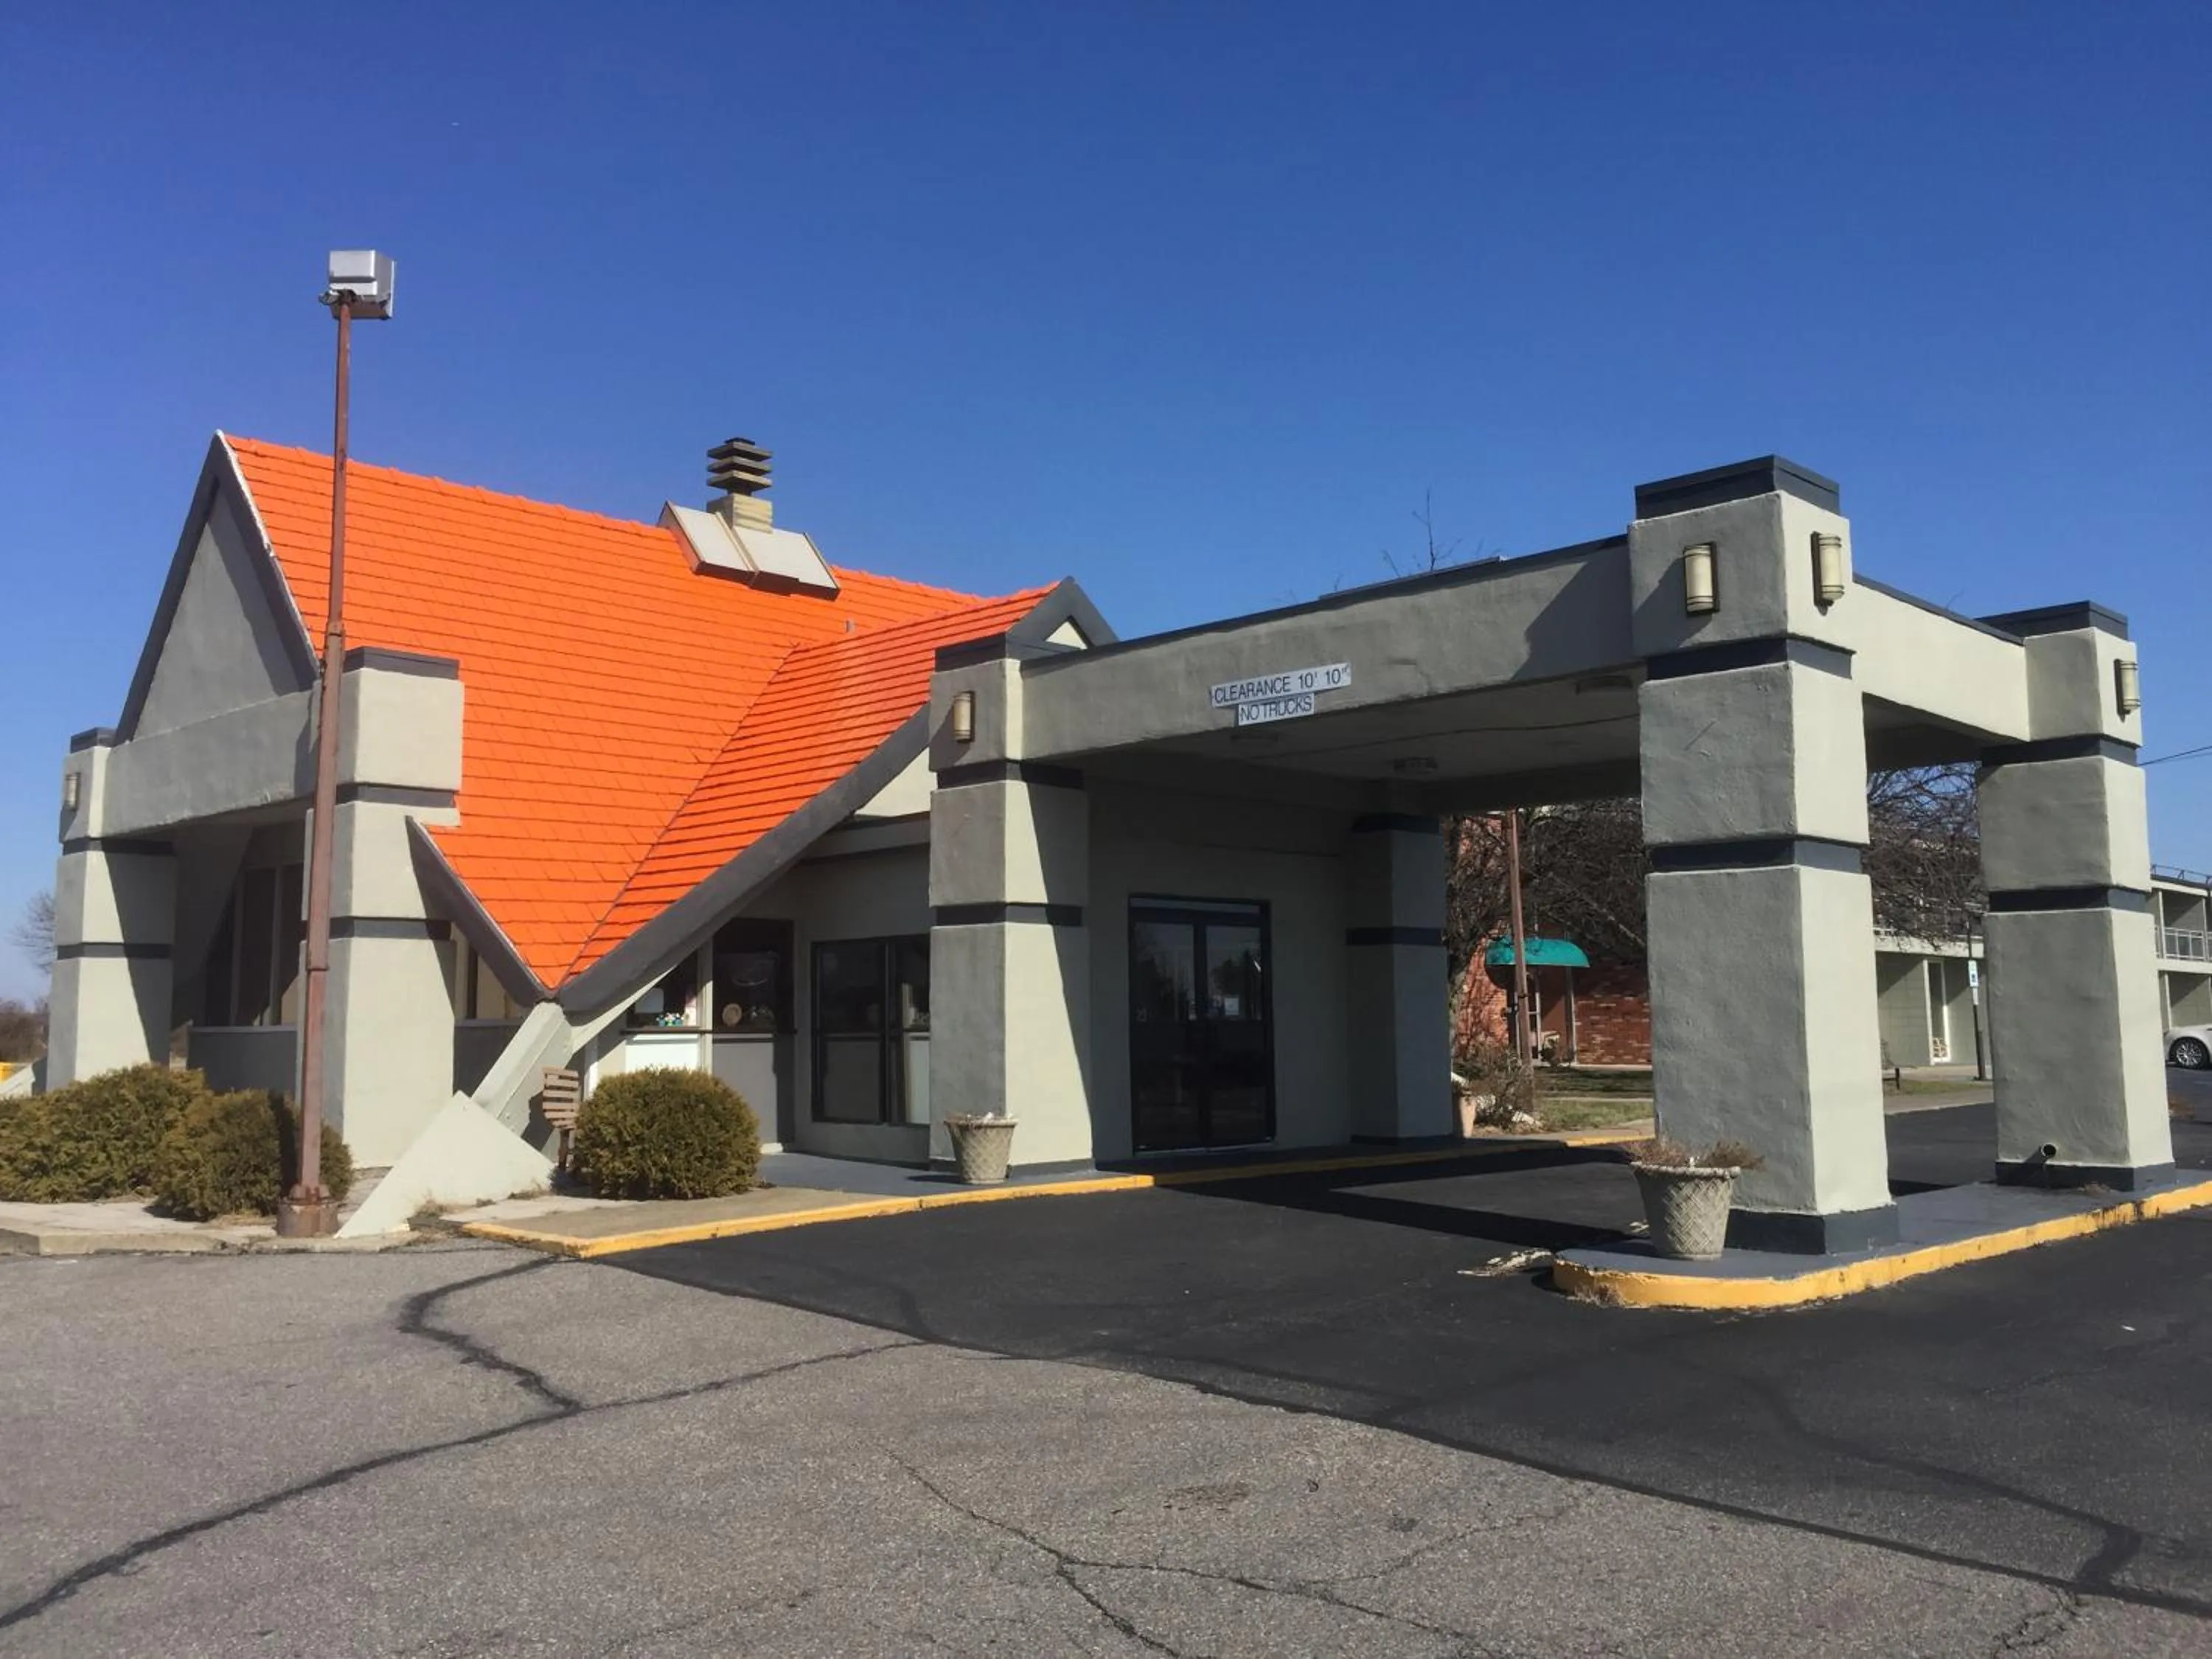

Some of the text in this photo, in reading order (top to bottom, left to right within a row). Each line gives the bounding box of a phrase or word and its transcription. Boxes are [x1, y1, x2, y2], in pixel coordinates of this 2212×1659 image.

[1214, 676, 1290, 703] CLEARANCE
[1298, 672, 1318, 689] 10'
[1239, 696, 1312, 722] NO TRUCKS
